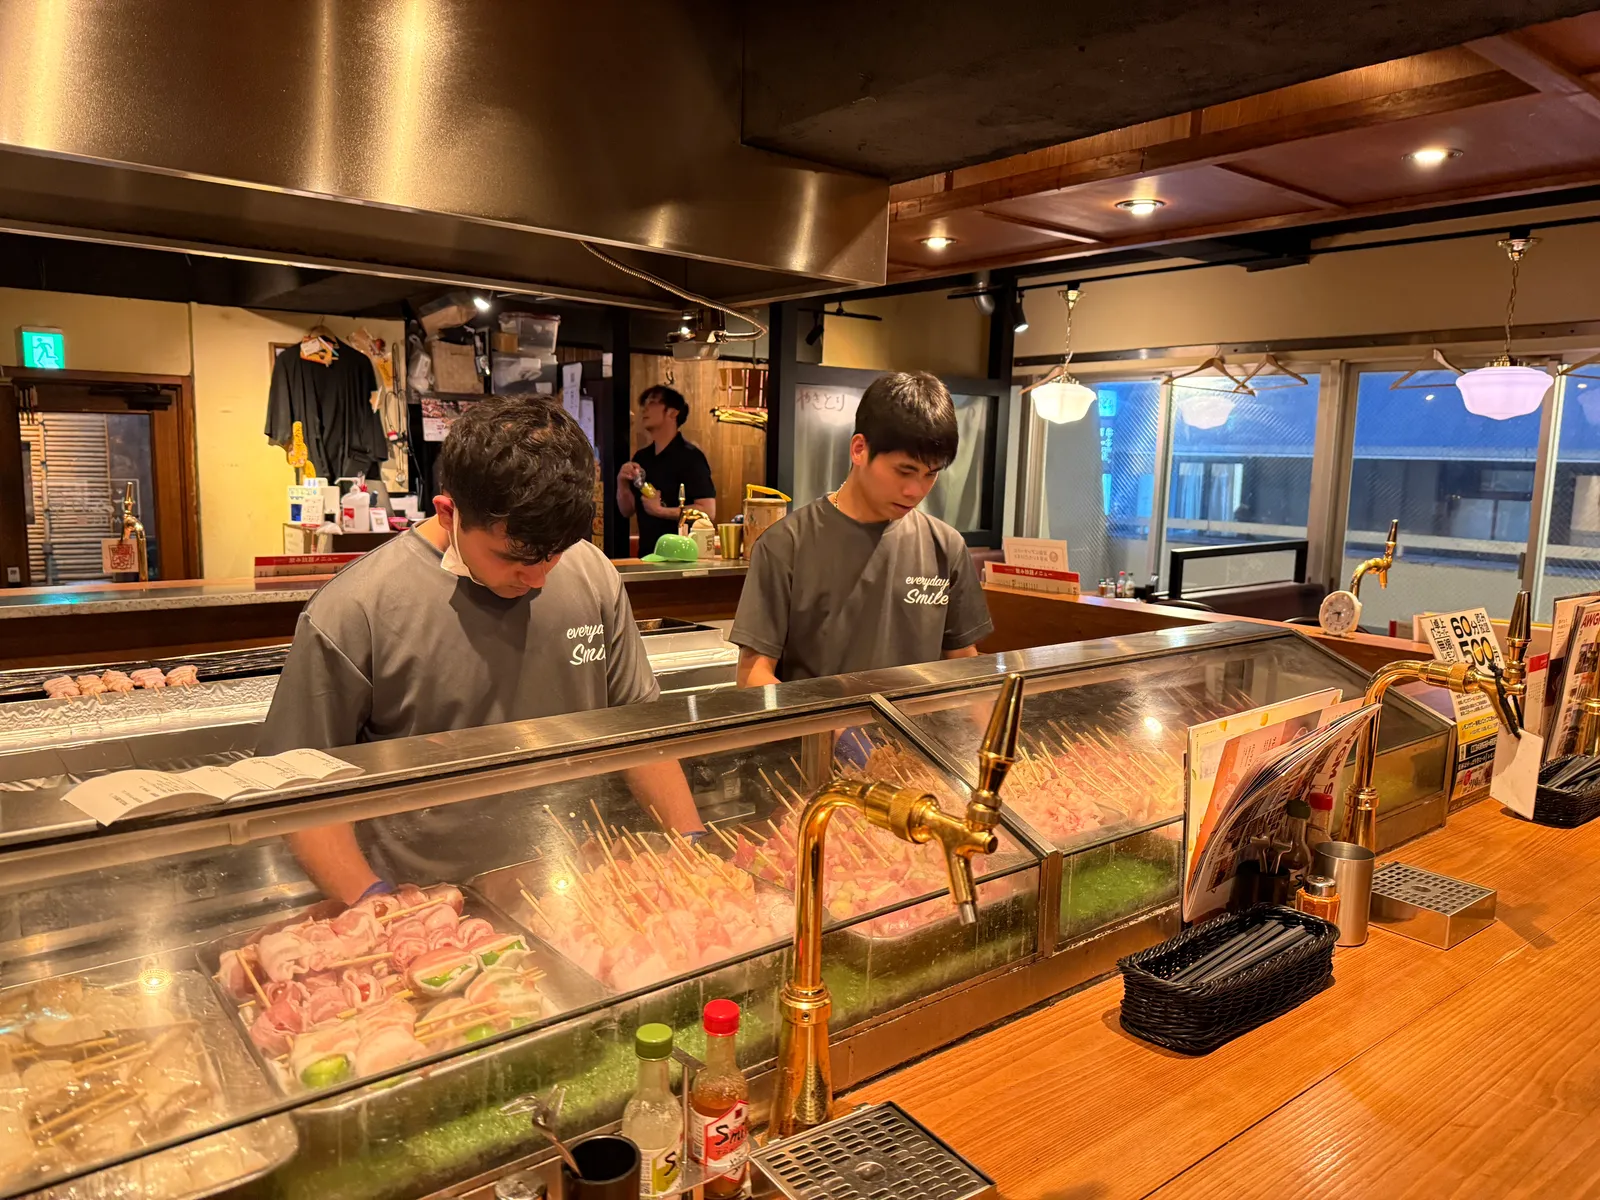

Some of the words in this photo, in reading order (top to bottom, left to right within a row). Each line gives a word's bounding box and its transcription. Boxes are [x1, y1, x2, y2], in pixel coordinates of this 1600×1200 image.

[905, 575, 950, 591] everyday
[903, 588, 949, 605] Smile
[569, 643, 606, 665] Smi
